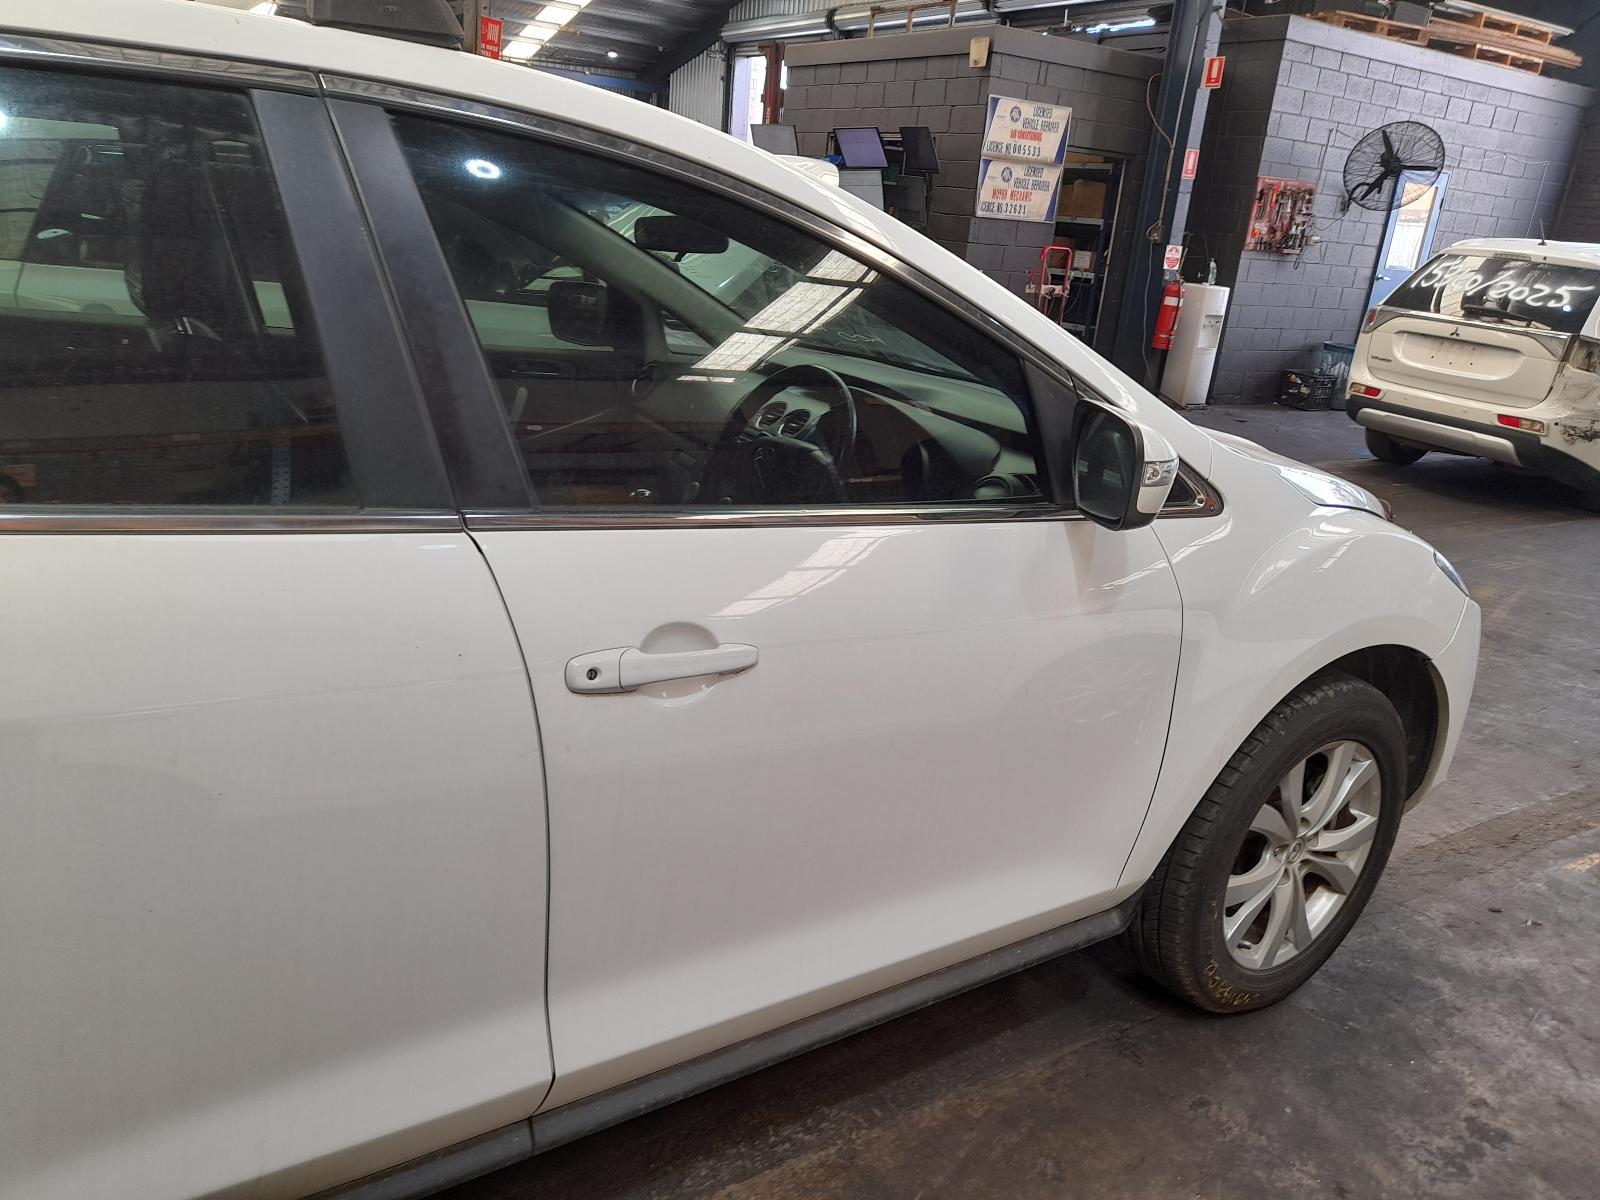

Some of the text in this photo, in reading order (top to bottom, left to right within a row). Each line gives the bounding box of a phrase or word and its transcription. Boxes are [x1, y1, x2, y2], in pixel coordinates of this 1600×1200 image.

[1022, 117, 1060, 133] VEHICLE REPAIRER
[1017, 130, 1042, 142] CONDITIONING
[1013, 178, 1051, 192] VEHICLE REPAIRER
[992, 188, 1033, 203] MOTOR MECHANIC
[1004, 203, 1026, 215] 32621
